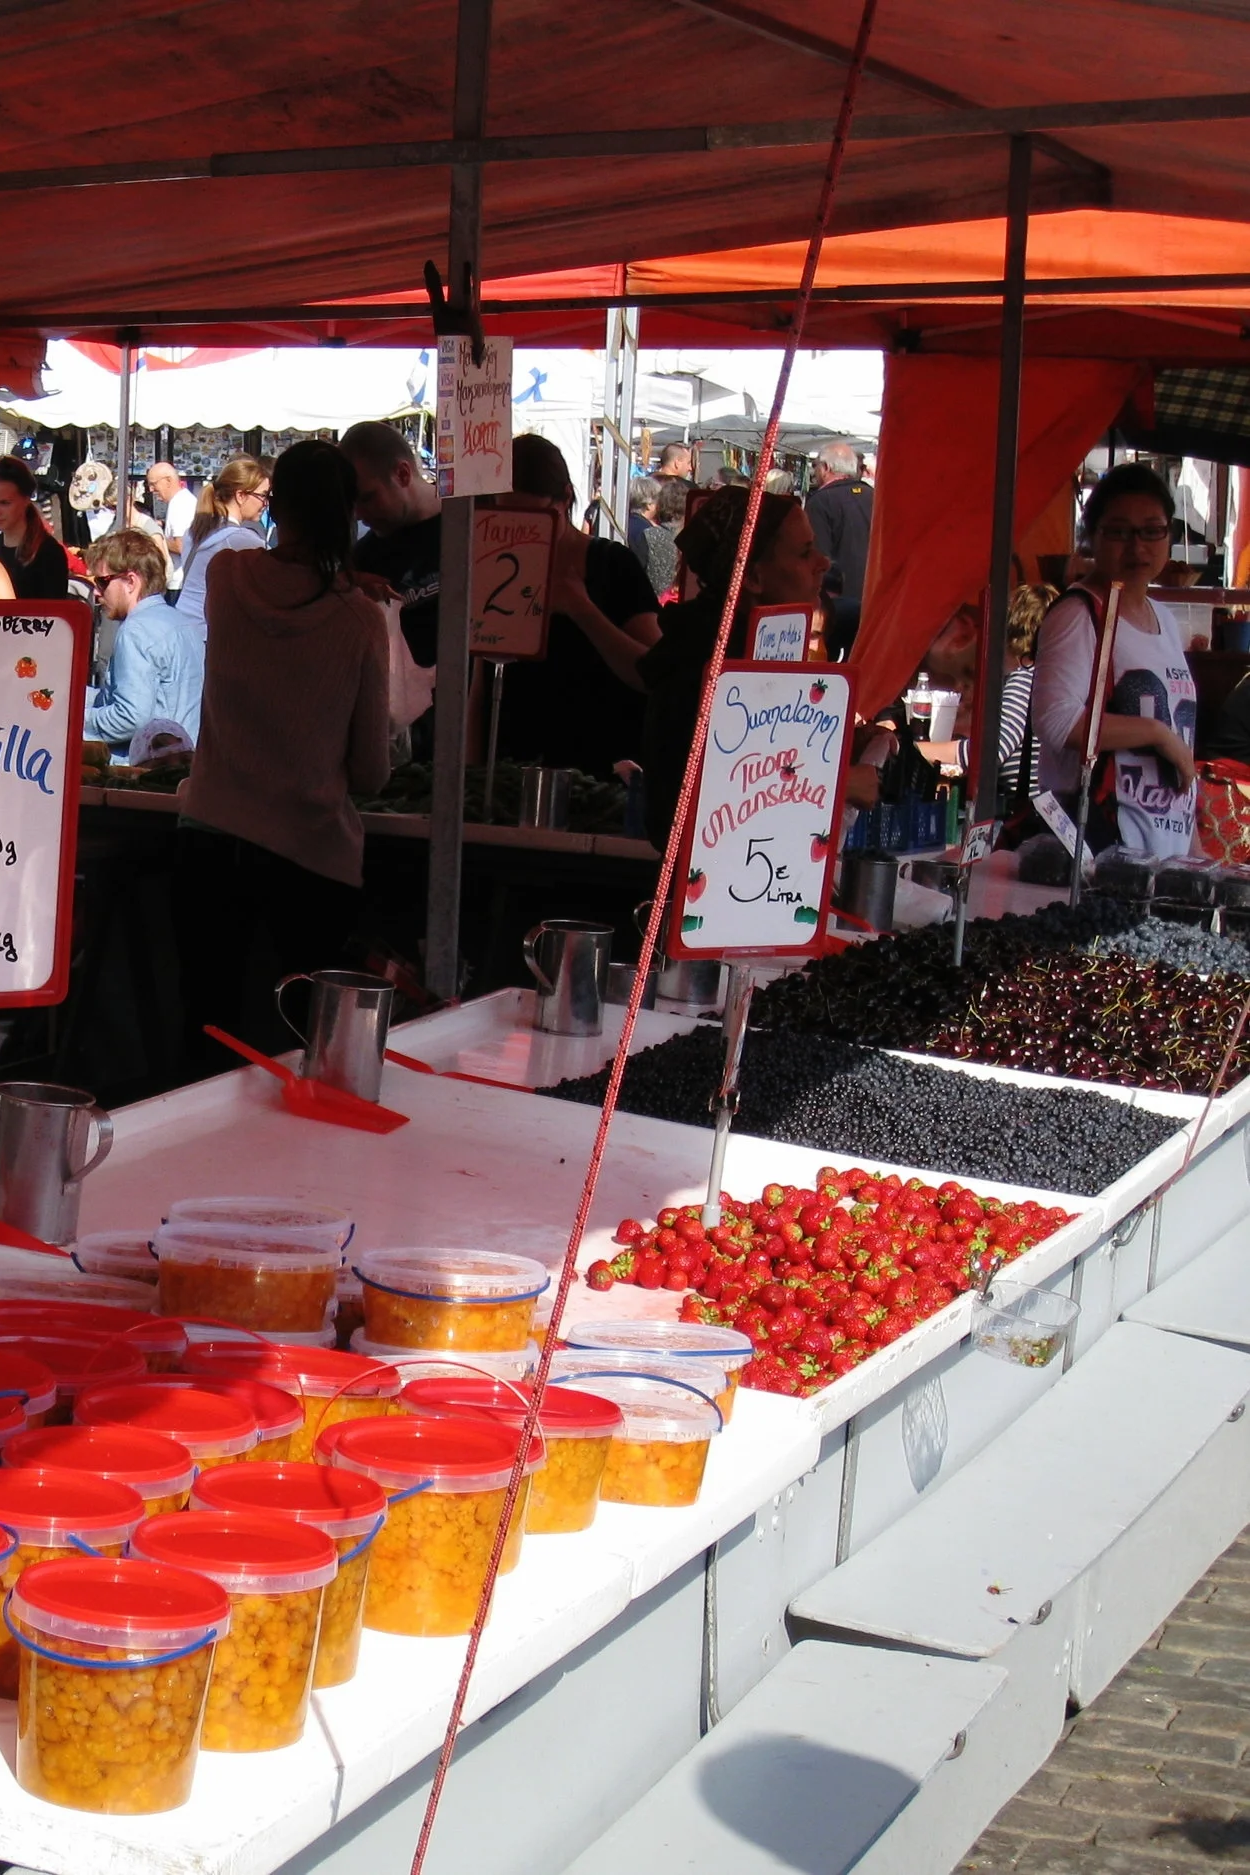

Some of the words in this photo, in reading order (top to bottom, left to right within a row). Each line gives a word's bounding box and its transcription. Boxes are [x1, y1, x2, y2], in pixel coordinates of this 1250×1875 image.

[476, 514, 541, 547] Tarjous
[714, 686, 840, 763] Suomalainen
[701, 774, 828, 850] Mansikka
